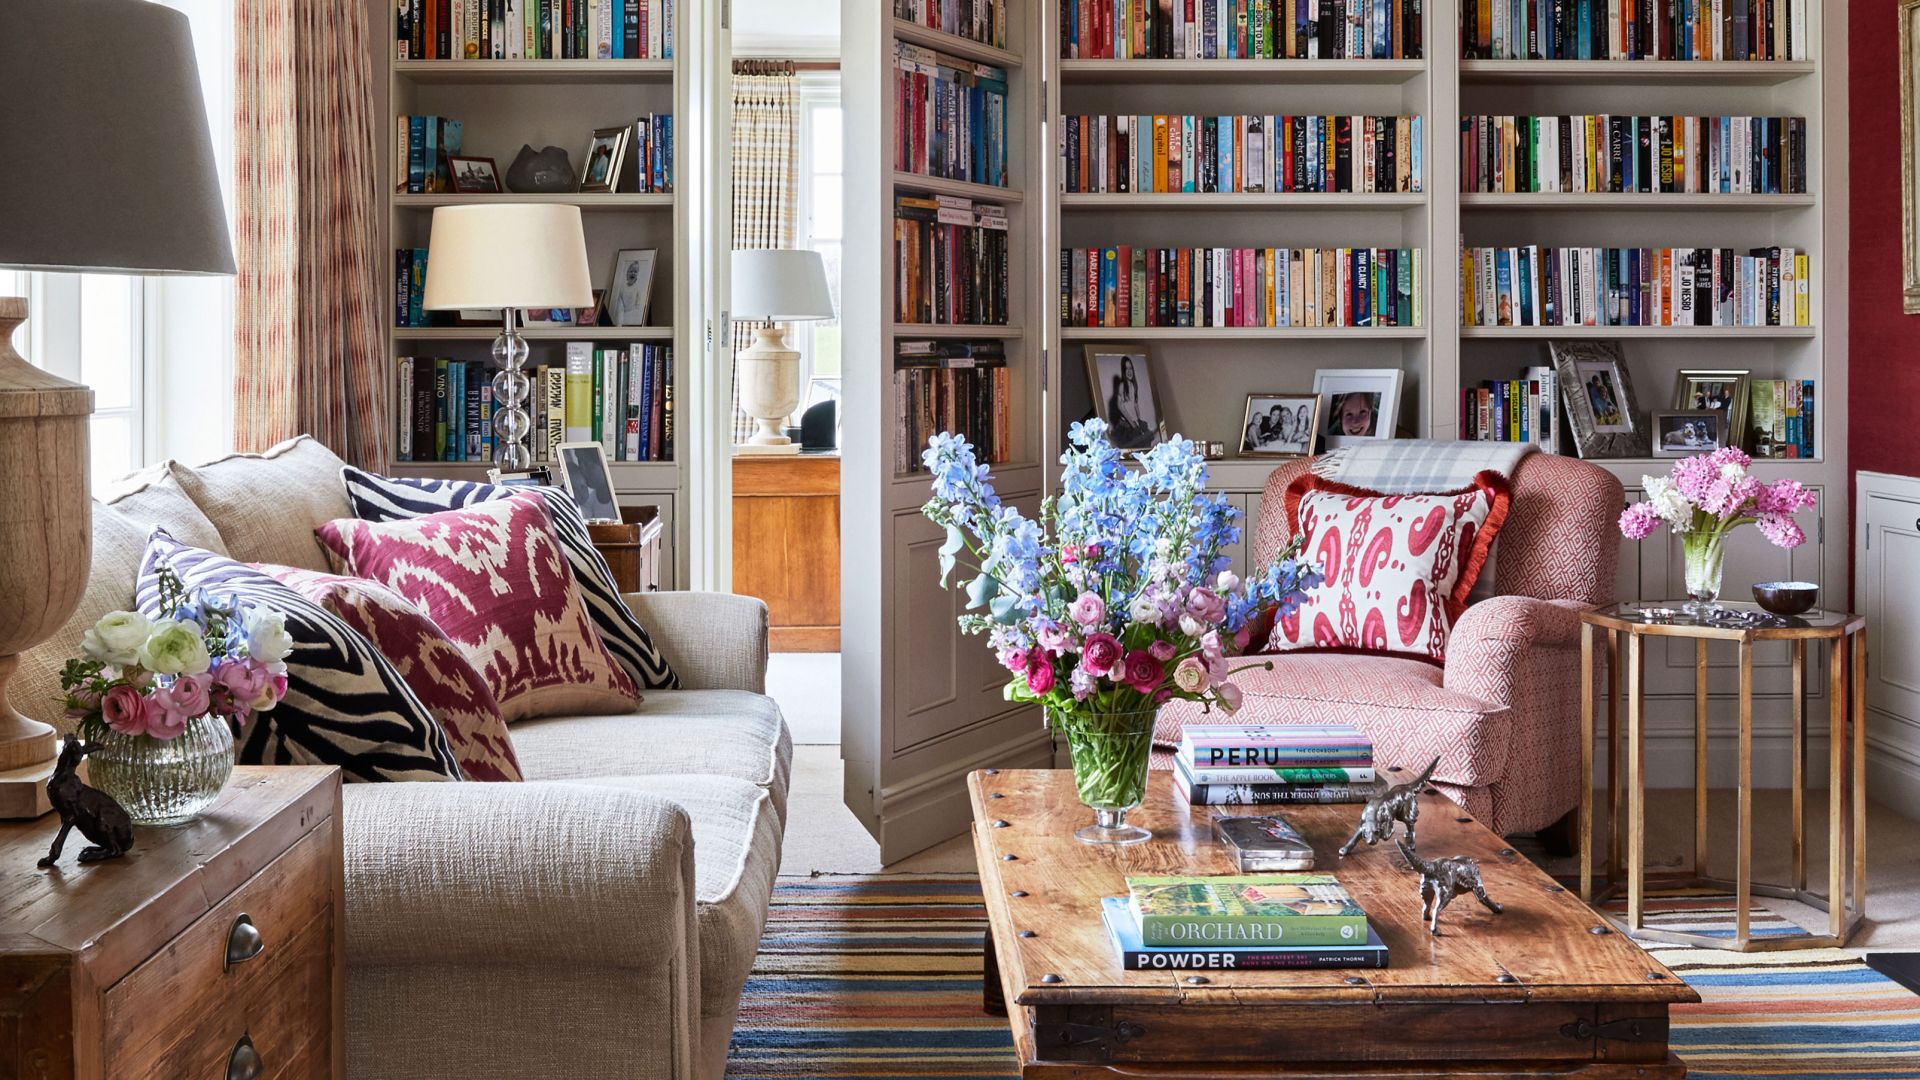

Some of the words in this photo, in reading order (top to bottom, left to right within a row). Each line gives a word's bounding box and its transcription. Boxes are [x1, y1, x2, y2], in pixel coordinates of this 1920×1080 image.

[1256, 30, 1263, 38] TO
[1155, 126, 1166, 155] Capital
[1296, 131, 1305, 153] Night
[1661, 145, 1672, 156] JO
[1297, 156, 1305, 181] Circus
[1089, 251, 1097, 283] HARLAN
[1358, 252, 1367, 264] TOM
[1358, 266, 1367, 289] CLANCY
[1682, 277, 1691, 286] JO
[1089, 284, 1097, 311] COBEN
[437, 374, 445, 398] VINO
[665, 385, 673, 399] 125
[1540, 373, 1548, 392] John
[1480, 391, 1488, 406] DEAN
[467, 390, 479, 435] SWIMMER
[1480, 408, 1488, 431] KOONTZ
[665, 413, 673, 440] YEARS
[1210, 747, 1280, 766] PERU
[1216, 774, 1230, 782] THE
[1232, 774, 1250, 782] APPLE
[1253, 774, 1274, 782] BOOK
[1253, 792, 1271, 800] SUN
[1272, 792, 1289, 800] THE
[1290, 791, 1319, 799] UNDER
[1321, 791, 1349, 799] LIVING
[1170, 922, 1283, 941] ORCHARD
[1137, 953, 1236, 968] POWDER
